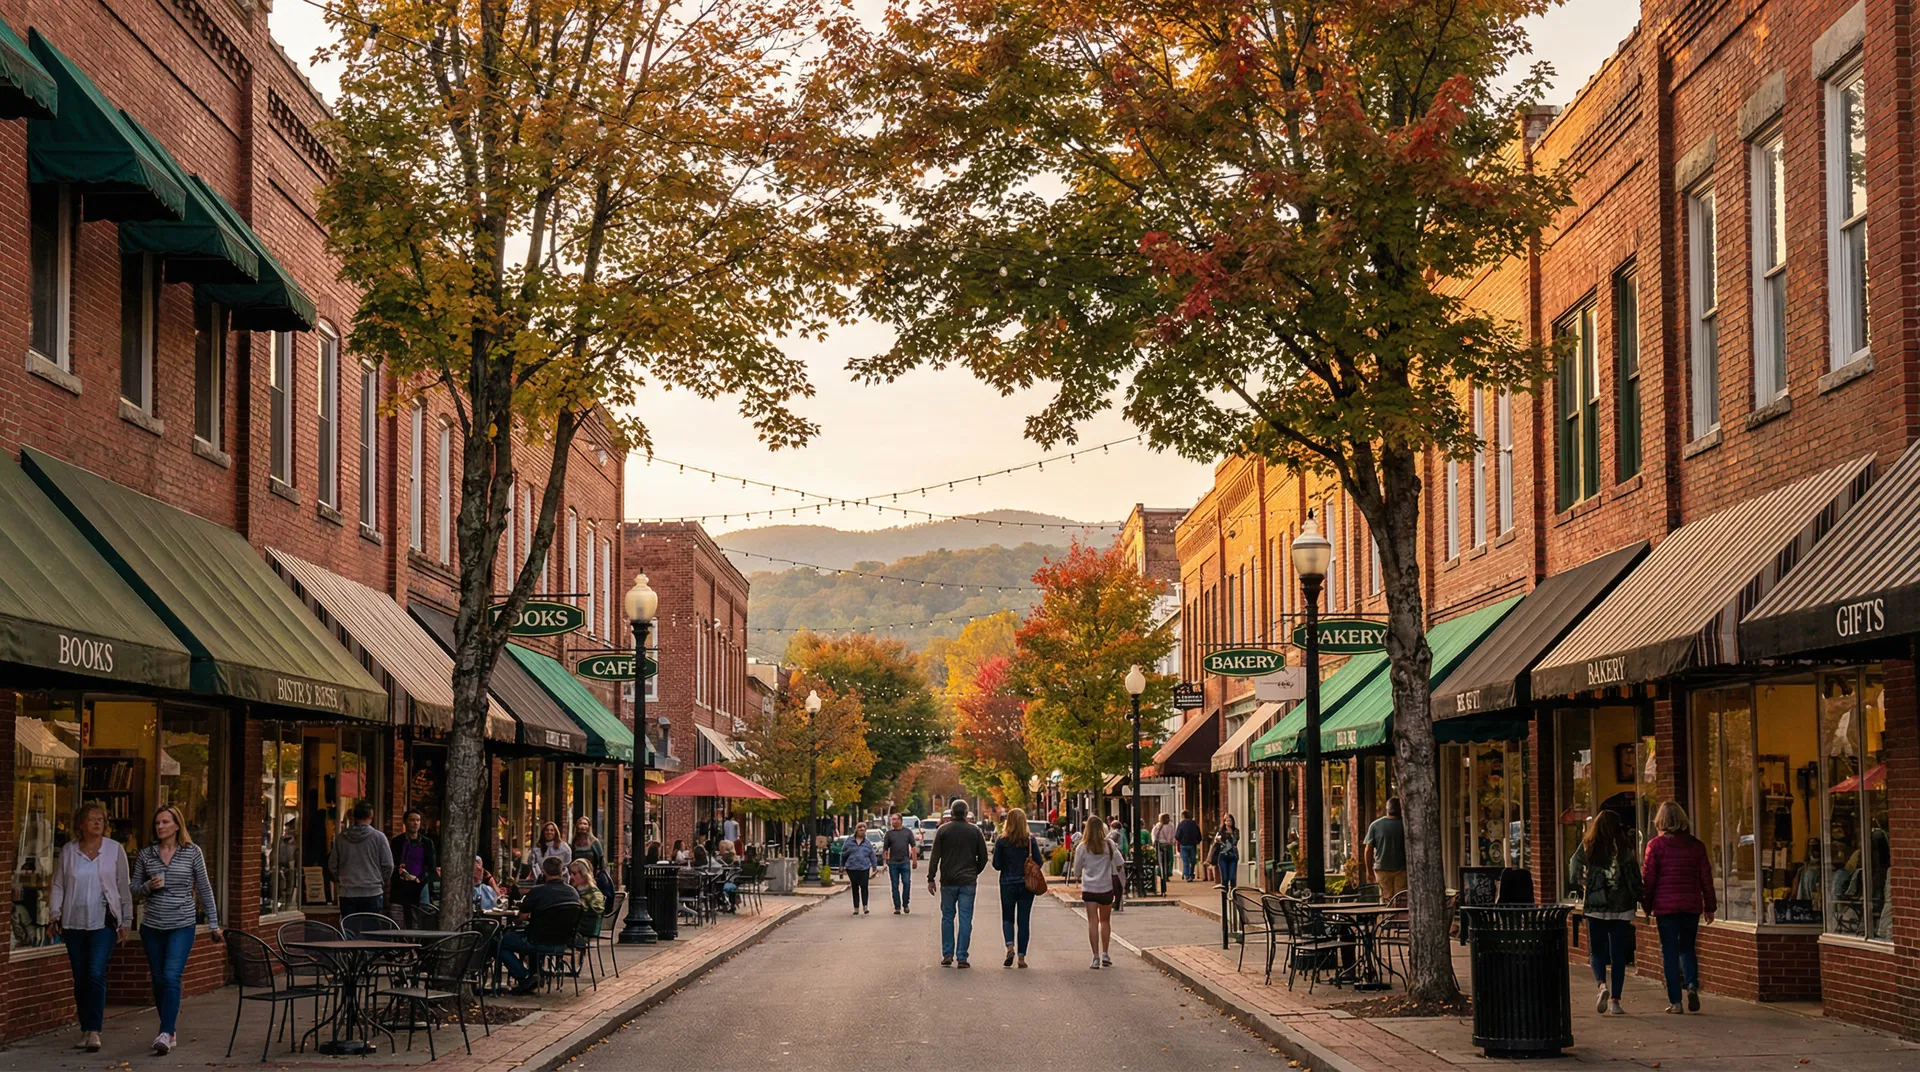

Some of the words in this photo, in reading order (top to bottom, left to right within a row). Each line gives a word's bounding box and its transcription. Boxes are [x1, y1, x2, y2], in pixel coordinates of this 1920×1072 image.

[1836, 598, 1885, 637] GIFTS
[58, 634, 114, 673] BOOKS
[1211, 655, 1279, 670] BAKERY
[1587, 655, 1626, 685] BAKERY
